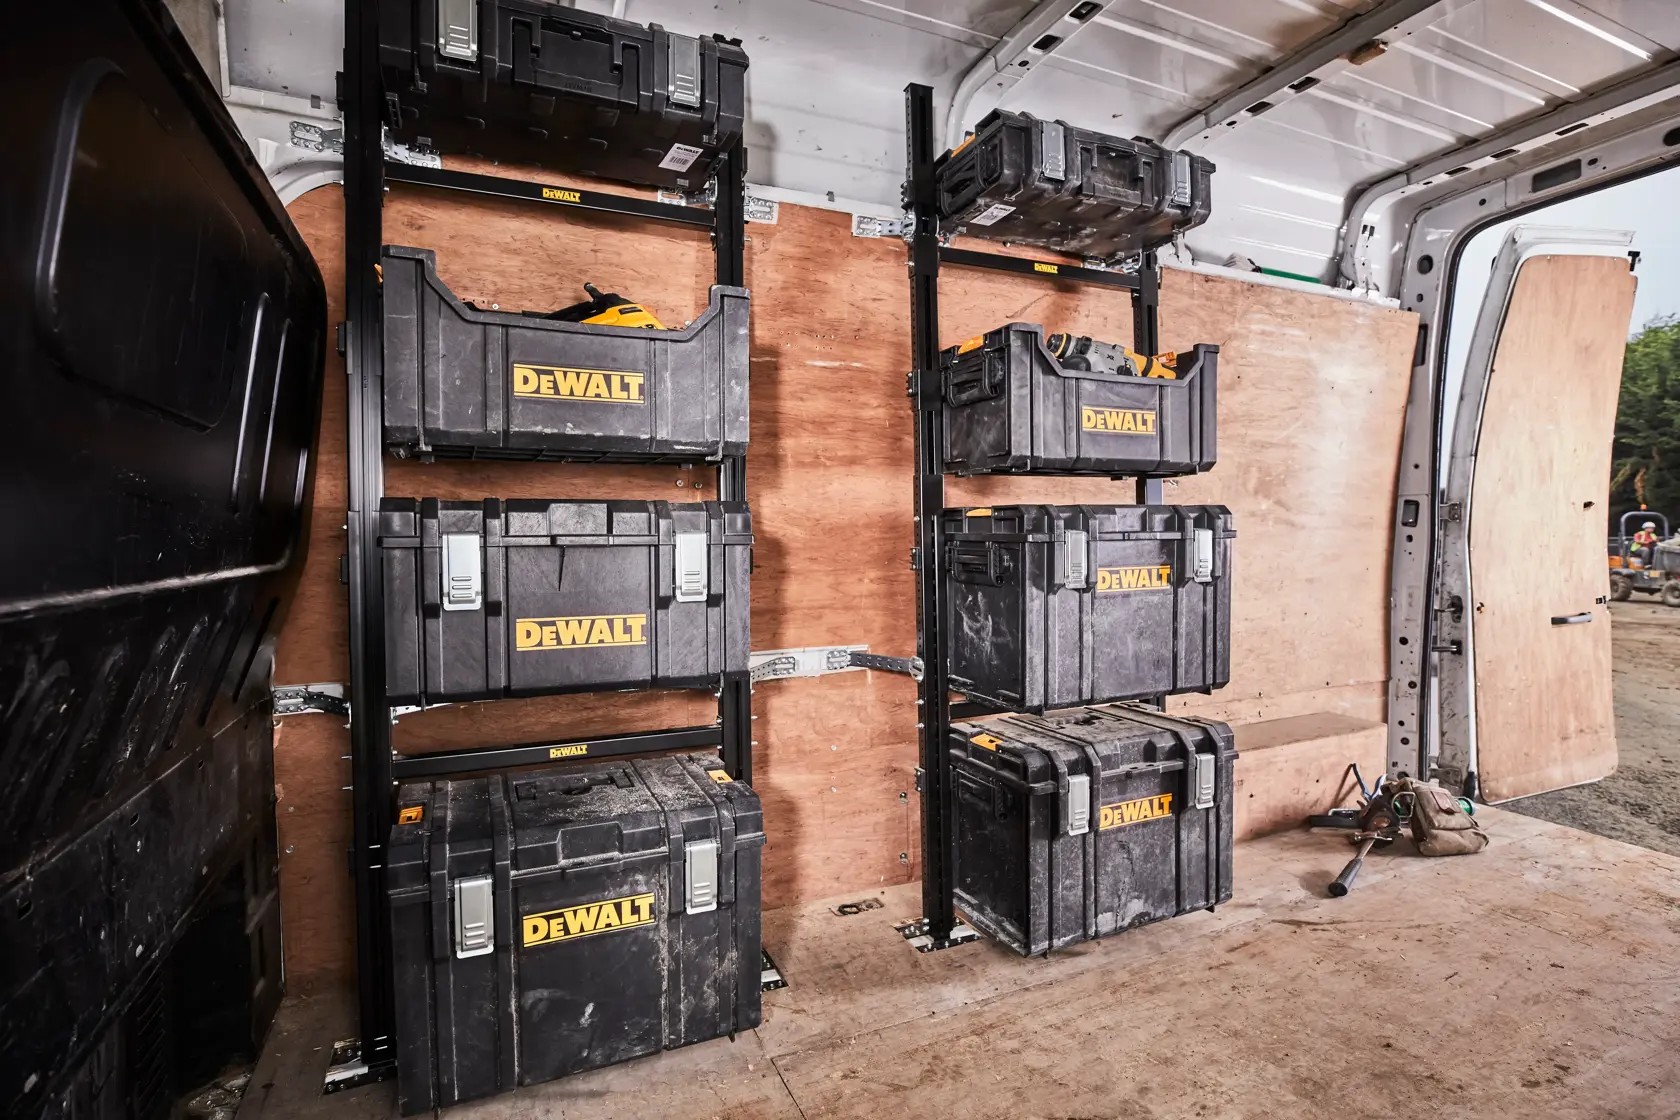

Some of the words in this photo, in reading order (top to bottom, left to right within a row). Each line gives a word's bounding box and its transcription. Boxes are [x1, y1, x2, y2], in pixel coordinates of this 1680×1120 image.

[543, 188, 580, 202] DEWALT
[514, 367, 644, 400] DEWALT
[1082, 409, 1156, 432] DEWALT
[1097, 568, 1170, 590] DEWALT
[516, 617, 646, 648] DEWALT
[550, 745, 587, 758] DEWALT
[1100, 795, 1172, 827] DEWALT
[523, 895, 655, 944] DEWALT
